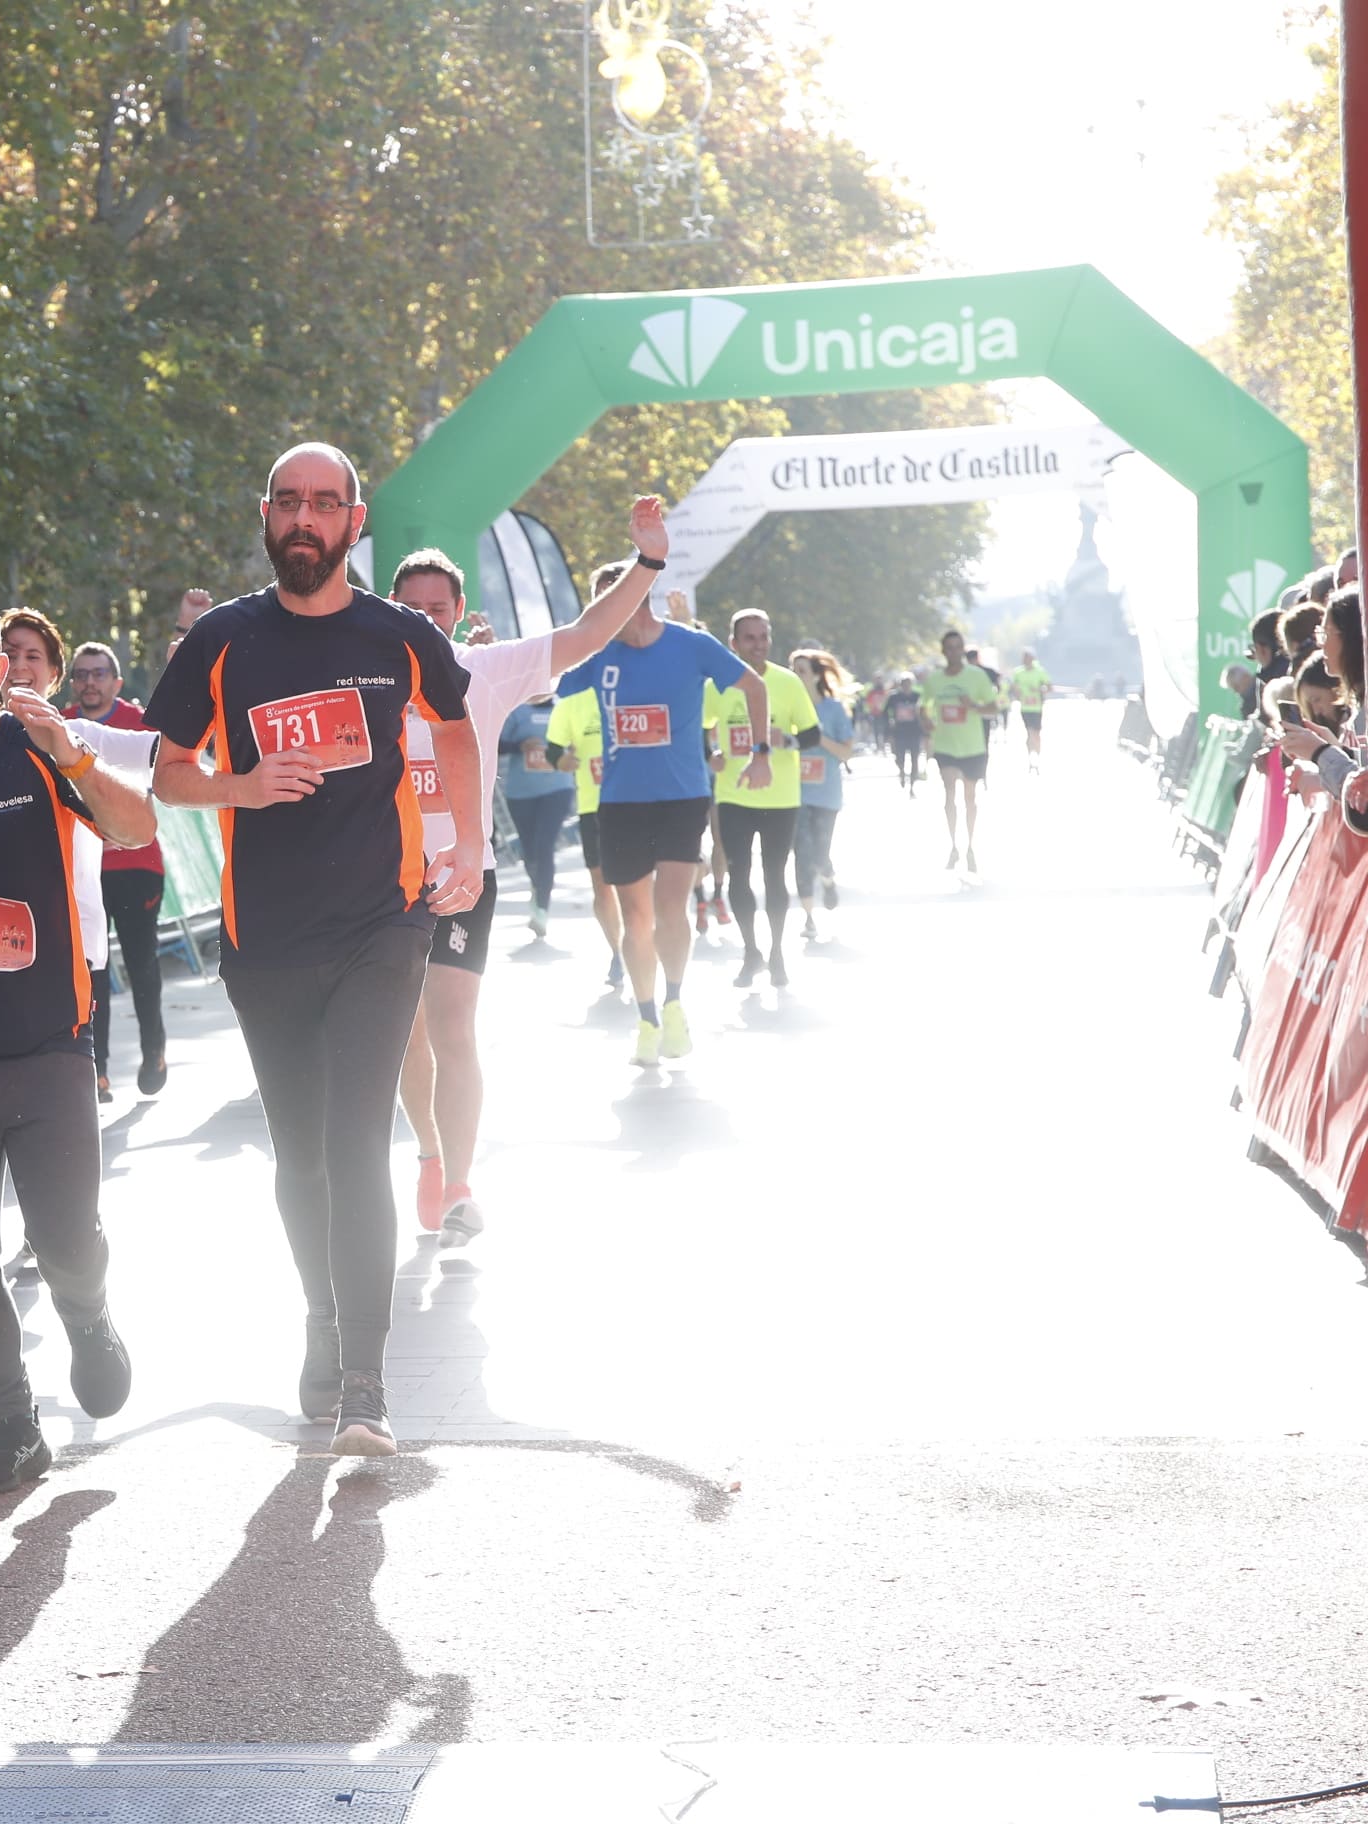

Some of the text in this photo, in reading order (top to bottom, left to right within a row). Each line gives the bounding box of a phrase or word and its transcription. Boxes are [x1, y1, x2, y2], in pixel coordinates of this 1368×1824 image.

[761, 305, 1019, 376] Unicaja
[771, 443, 1061, 491] El Norte de Castilla
[336, 676, 353, 687] red
[267, 709, 321, 752] 731
[621, 713, 648, 732] 220
[411, 769, 437, 795] 98
